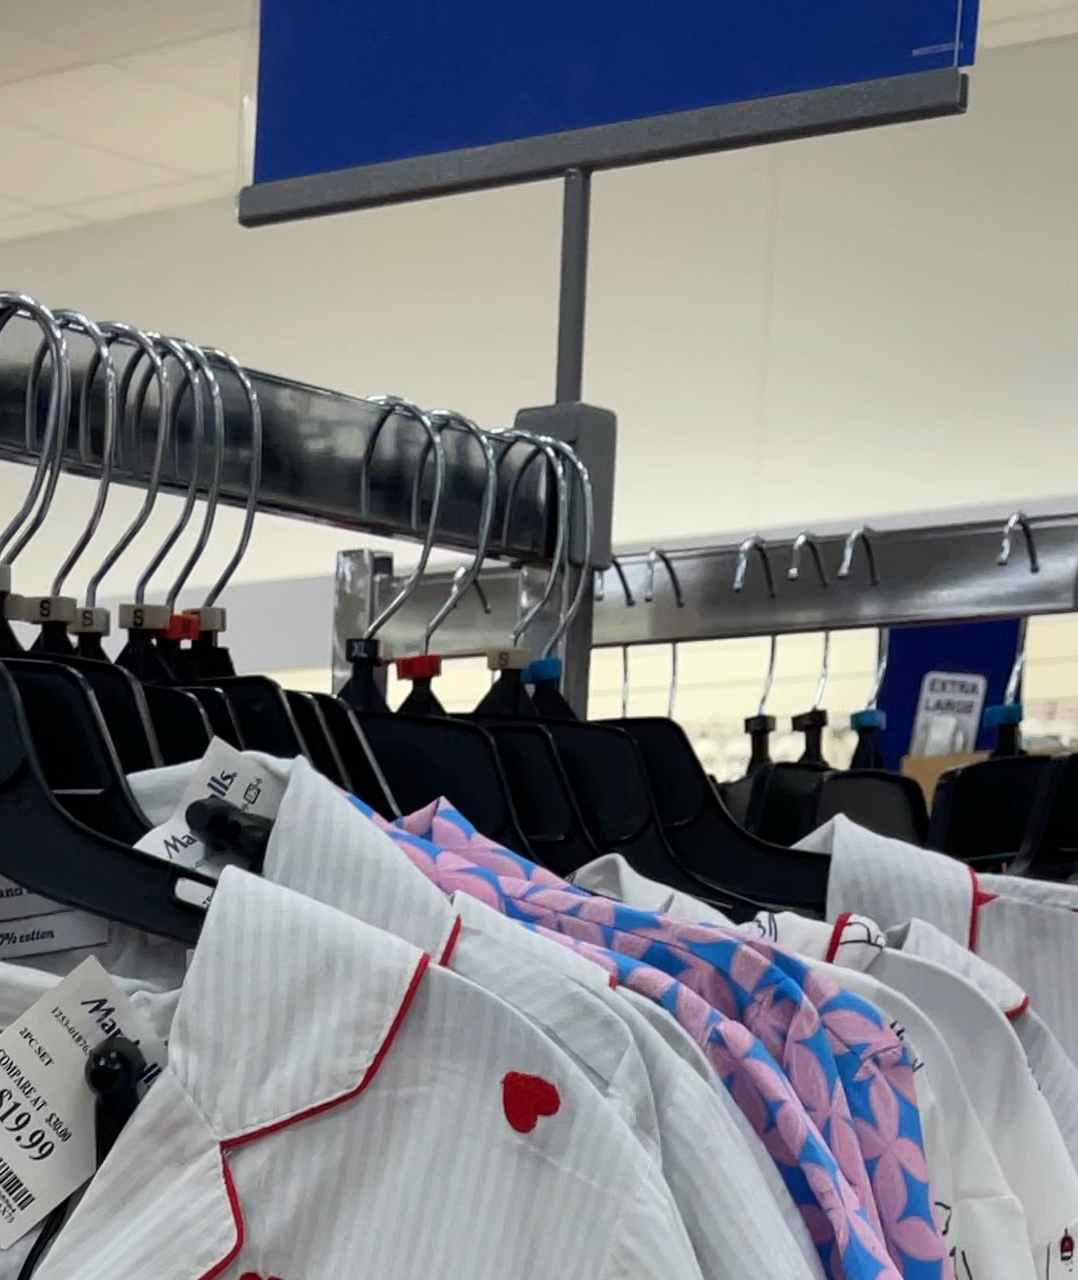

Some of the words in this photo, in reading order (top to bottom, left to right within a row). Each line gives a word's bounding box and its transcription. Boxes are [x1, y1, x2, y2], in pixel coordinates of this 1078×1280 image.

[40, 600, 51, 617] S
[82, 610, 94, 627] S
[133, 609, 144, 627] S
[929, 678, 979, 694] EXTRA
[925, 698, 973, 713] LARGE
[19, 929, 55, 944] cotton
[19, 1027, 39, 1048] 2PC
[34, 1046, 55, 1067] SET
[30, 1095, 48, 1111] AT
